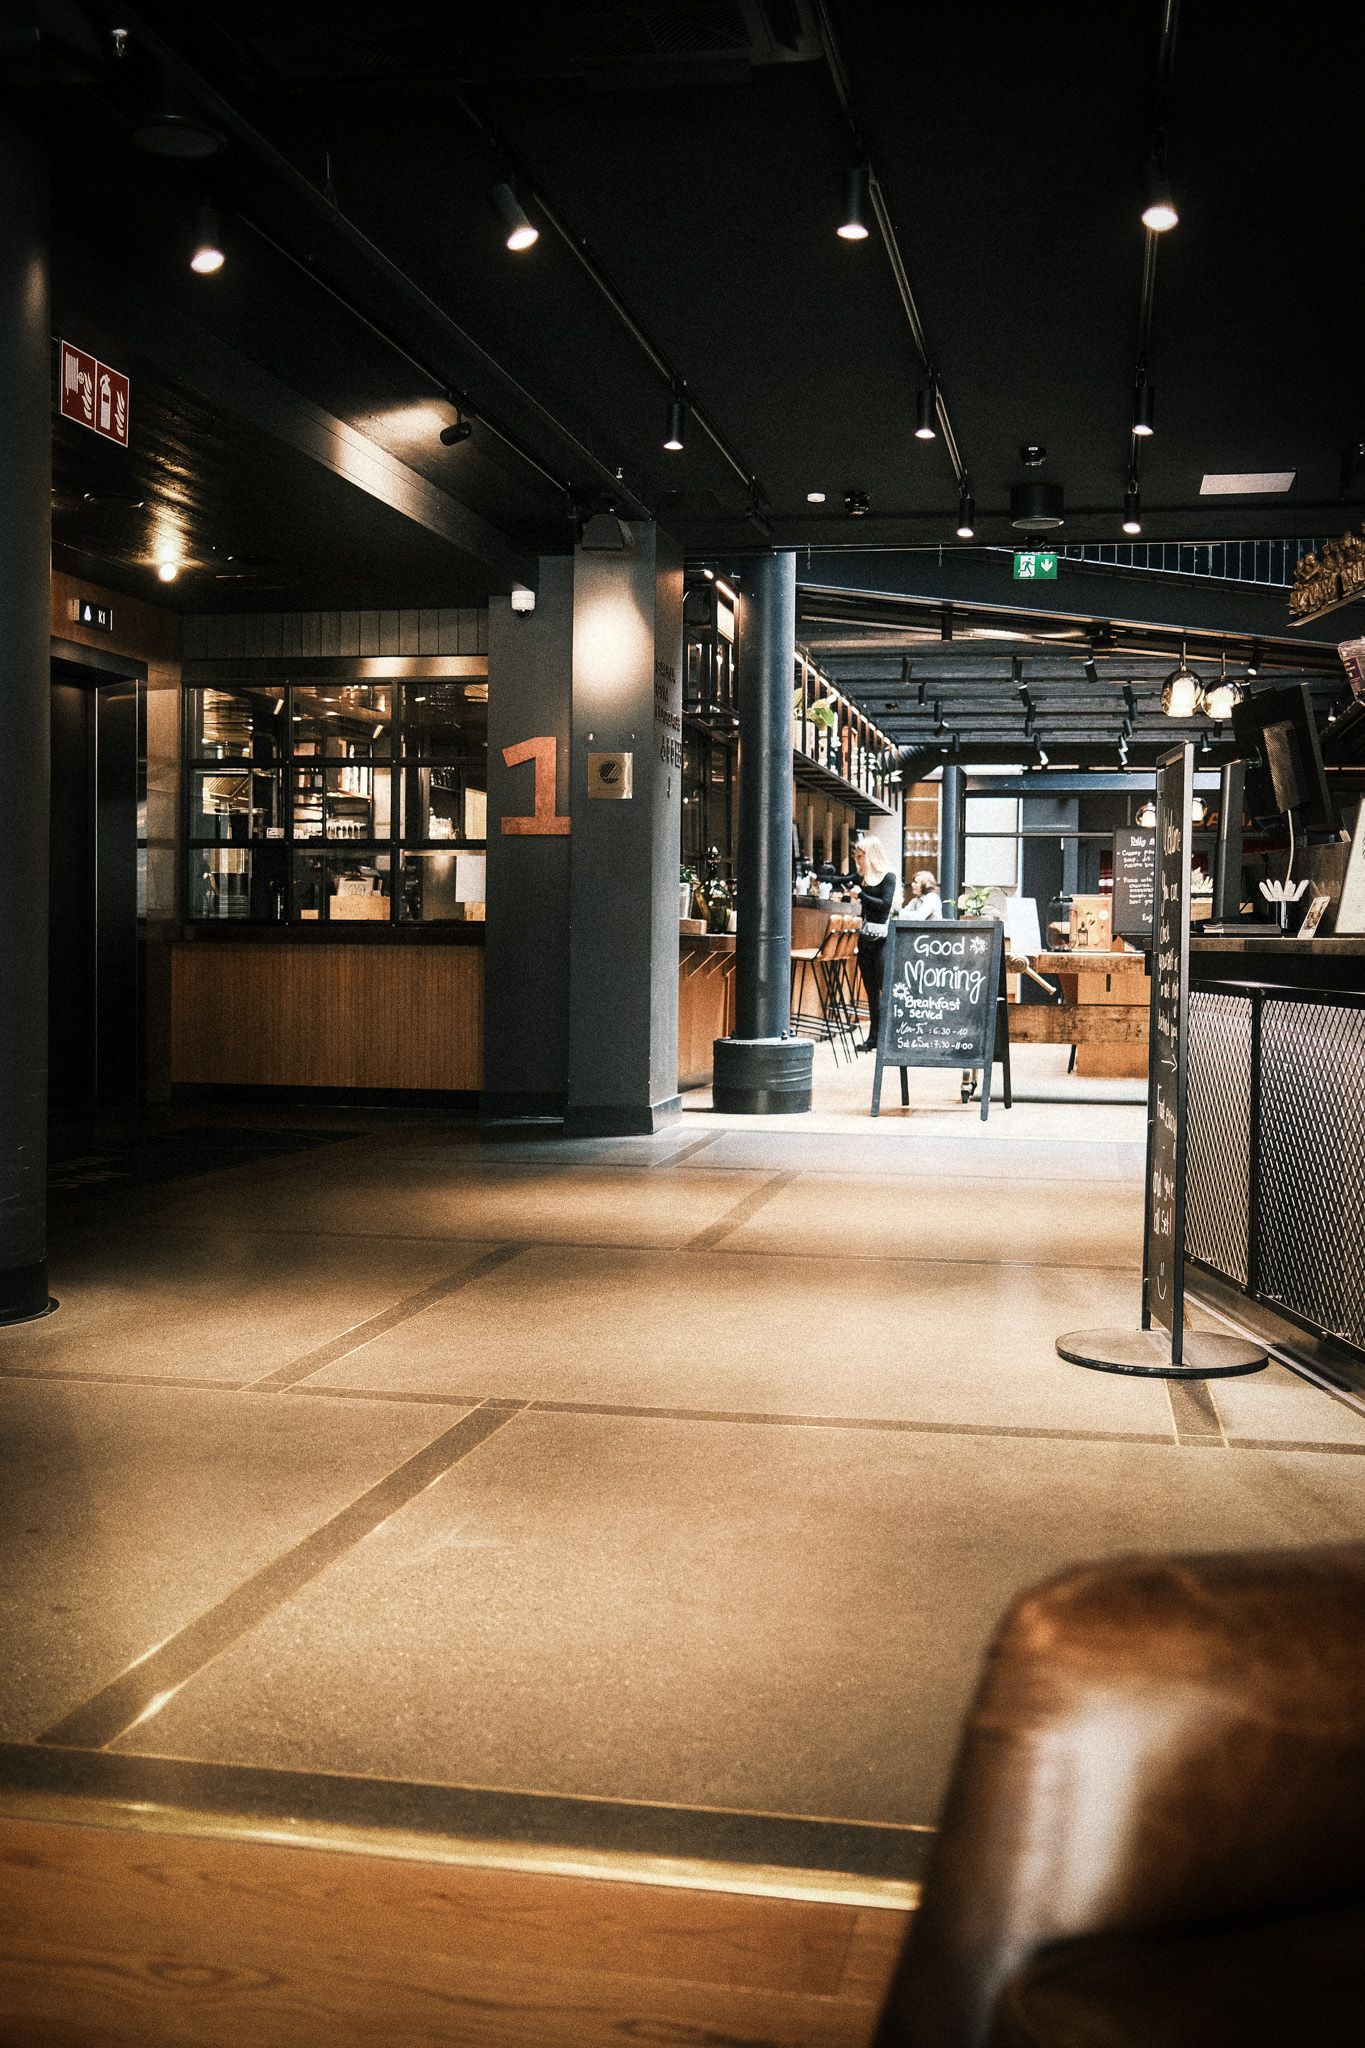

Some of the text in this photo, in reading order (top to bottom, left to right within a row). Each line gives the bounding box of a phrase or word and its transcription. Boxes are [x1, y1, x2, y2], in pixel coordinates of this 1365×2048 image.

[501, 736, 572, 836] 1
[914, 934, 965, 956] Good
[904, 960, 986, 1004] Morning
[904, 995, 960, 1011] Breakfast
[909, 1008, 943, 1020] served
